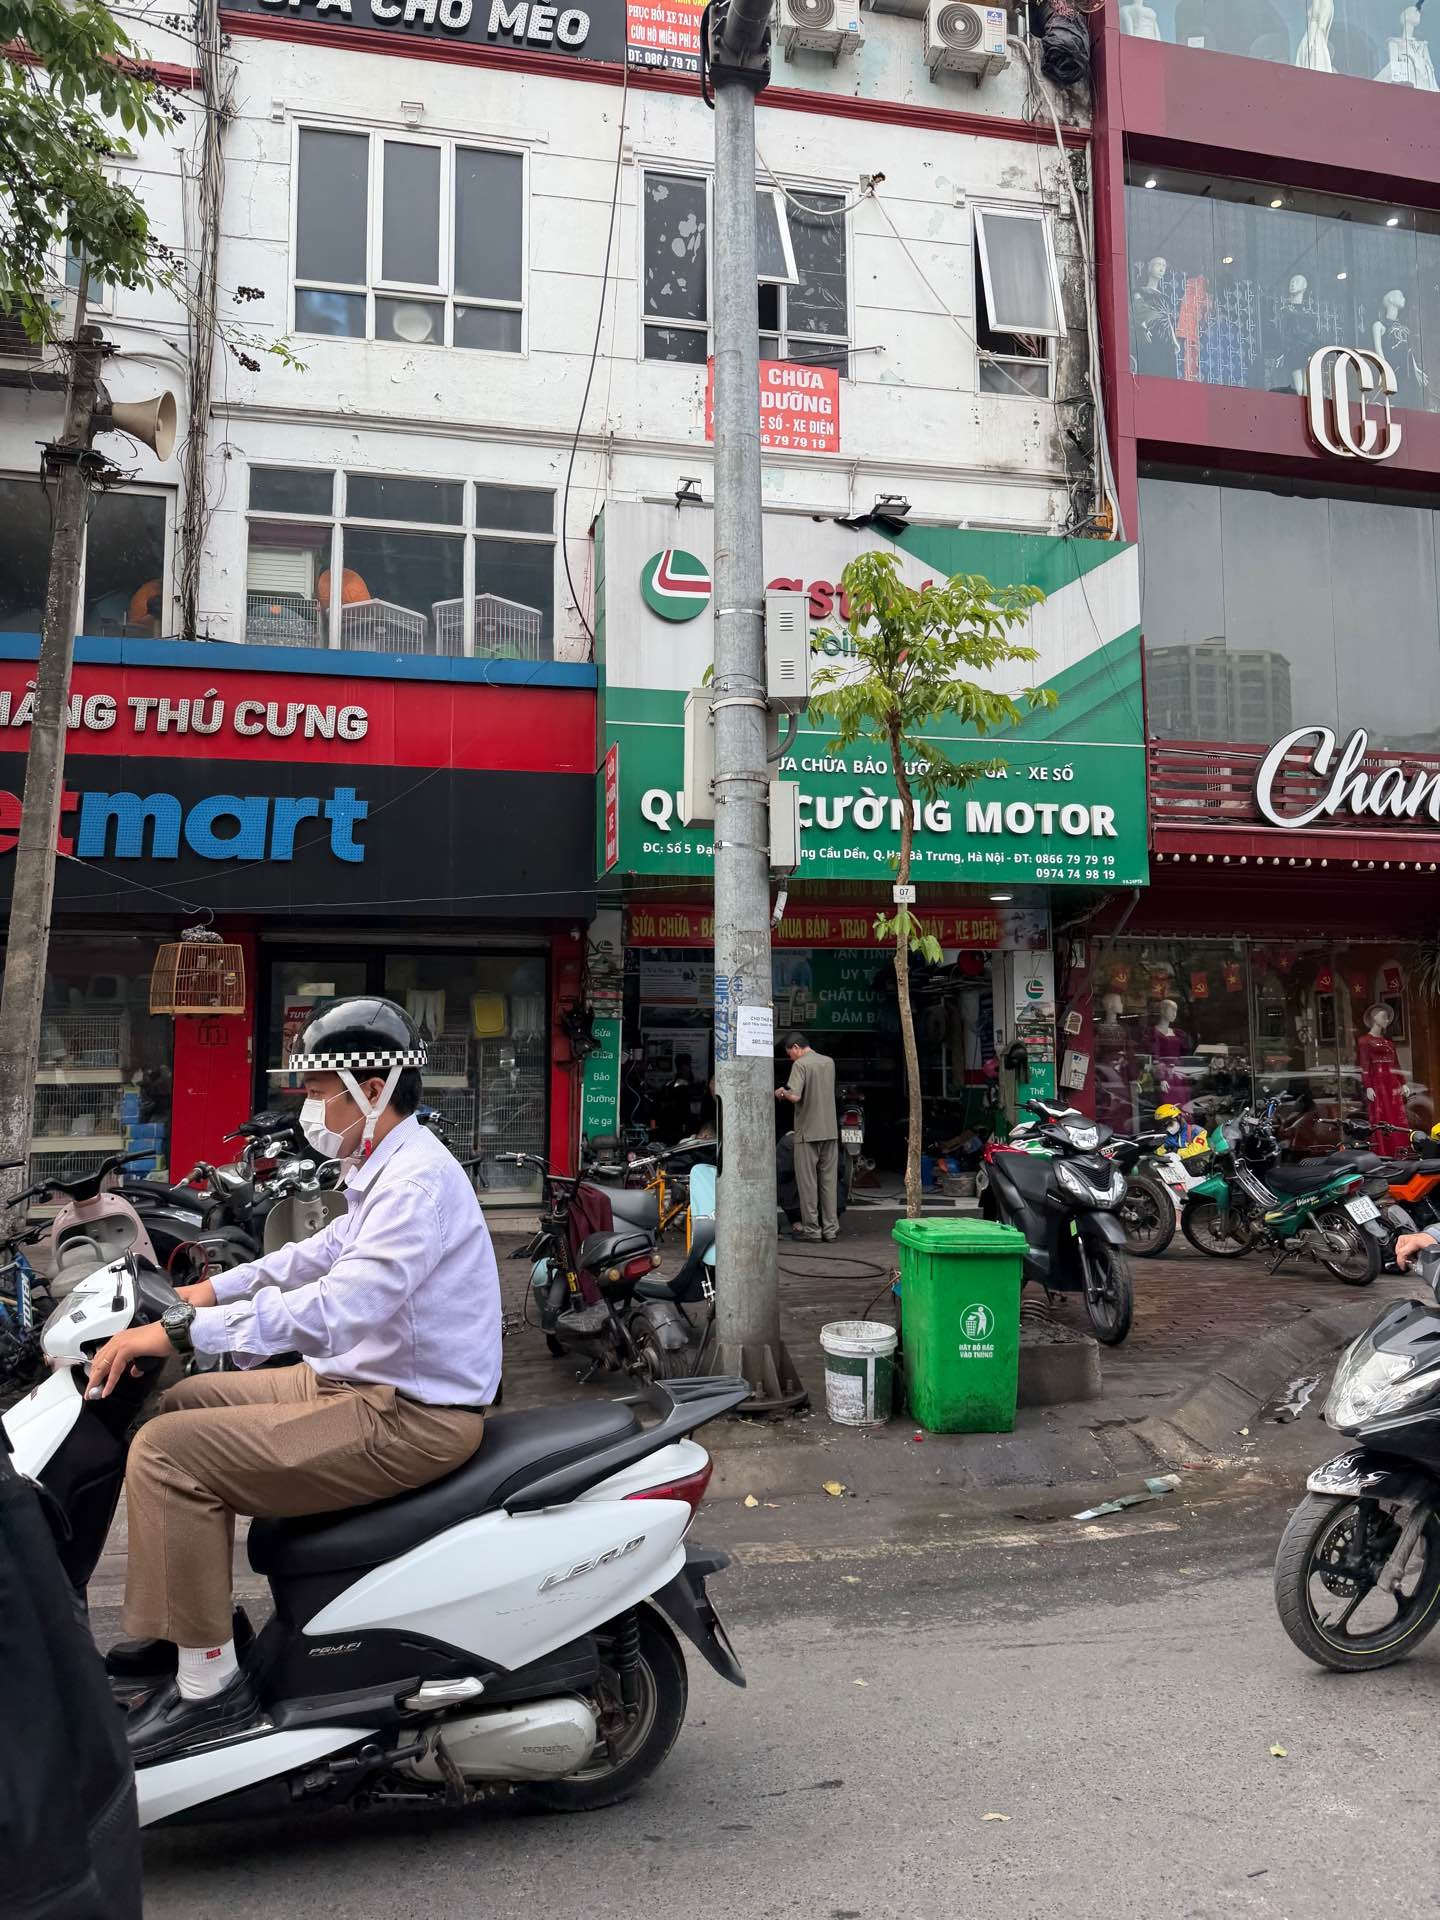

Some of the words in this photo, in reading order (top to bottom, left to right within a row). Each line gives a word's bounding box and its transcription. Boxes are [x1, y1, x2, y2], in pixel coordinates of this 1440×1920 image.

[666, 11, 677, 24] XE
[671, 57, 683, 68] 79
[685, 59, 698, 71] 79
[768, 368, 824, 389] CHỮA
[761, 391, 832, 414] DƯỠNG
[769, 413, 783, 430] SỐ
[793, 419, 806, 433] XE
[809, 419, 834, 437] ĐIỆN
[774, 435, 789, 445] 79
[793, 437, 807, 447] 79
[812, 439, 826, 448] 19
[128, 688, 225, 735] THÚ
[234, 701, 369, 741] CƯNG
[801, 755, 847, 773] CHỮA
[853, 756, 887, 774] BẢO
[1028, 767, 1048, 780] XE
[1052, 763, 1074, 781] SỐ
[798, 786, 952, 832] CƯỜNG
[966, 801, 1118, 837] MOTOR
[643, 843, 663, 853] ĐC:
[667, 841, 682, 854] Số
[685, 844, 691, 854] 5
[819, 848, 841, 859] Cầu
[967, 852, 983, 863] Hà
[985, 852, 1005, 865] Nội
[1014, 853, 1032, 864] ĐT:
[1036, 854, 1063, 864] 0866
[1067, 854, 1081, 864] 79
[1085, 855, 1098, 865] 79
[1103, 855, 1115, 865] 19
[1036, 868, 1064, 878] 0974
[1067, 869, 1081, 879] 74
[1085, 869, 1099, 879] 98
[1103, 870, 1116, 880] 19
[632, 909, 655, 937] SỬA
[658, 912, 690, 937] CHỮA
[777, 918, 802, 939] MUA
[839, 919, 868, 939] TRAO
[955, 919, 970, 939] XE
[594, 1028, 611, 1037] Sửa
[593, 1072, 610, 1081] Bảo
[586, 1094, 616, 1104] Dưỡng
[588, 1117, 600, 1125] Xe
[601, 1118, 612, 1127] ga
[538, 1534, 646, 1591] LEAD
